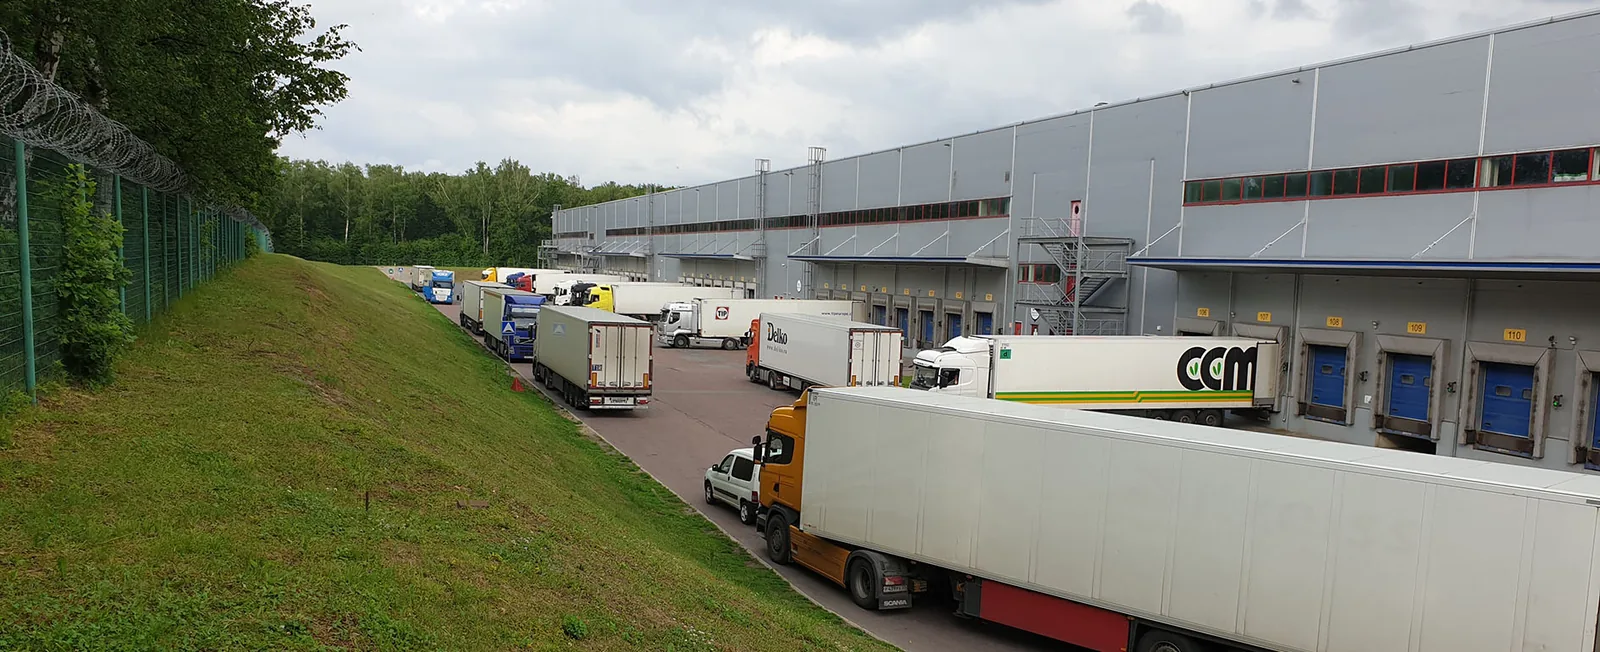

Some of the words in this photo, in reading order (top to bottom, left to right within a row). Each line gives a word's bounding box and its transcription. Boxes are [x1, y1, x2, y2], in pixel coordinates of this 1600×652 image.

[1329, 318, 1340, 326] 108
[1410, 324, 1423, 332] 109
[767, 322, 788, 345] Delko
[1508, 331, 1522, 340] 110
[883, 599, 908, 607] SCANIA
